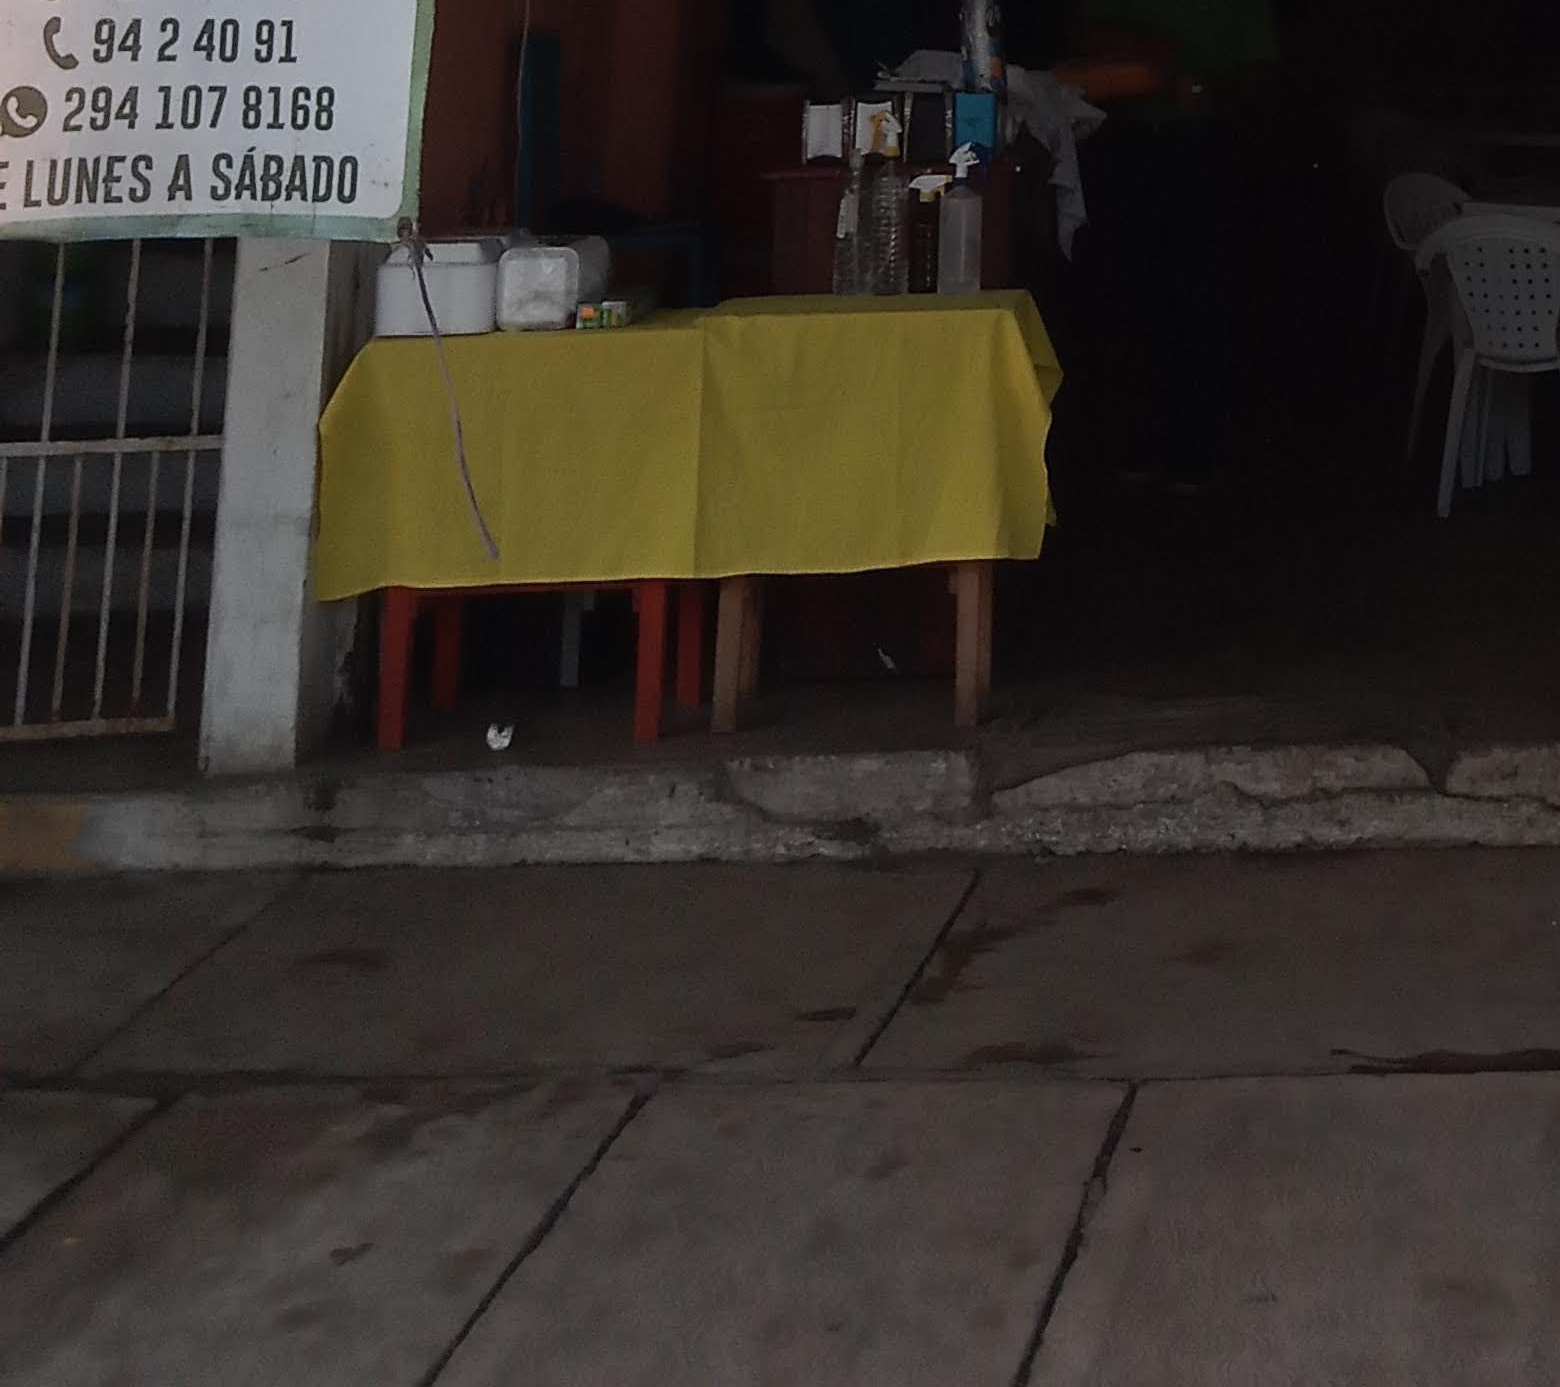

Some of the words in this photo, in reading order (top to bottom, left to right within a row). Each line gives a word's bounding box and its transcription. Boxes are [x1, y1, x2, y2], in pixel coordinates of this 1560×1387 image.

[92, 18, 142, 62] 94
[158, 18, 179, 62] 2
[194, 18, 239, 62] 40
[255, 18, 297, 63] 91
[63, 85, 138, 131] 294
[155, 85, 228, 129] 107
[242, 85, 335, 130] 8168
[24, 153, 153, 208] LUNES
[168, 154, 192, 202] A
[210, 147, 357, 204] SÁBADO
